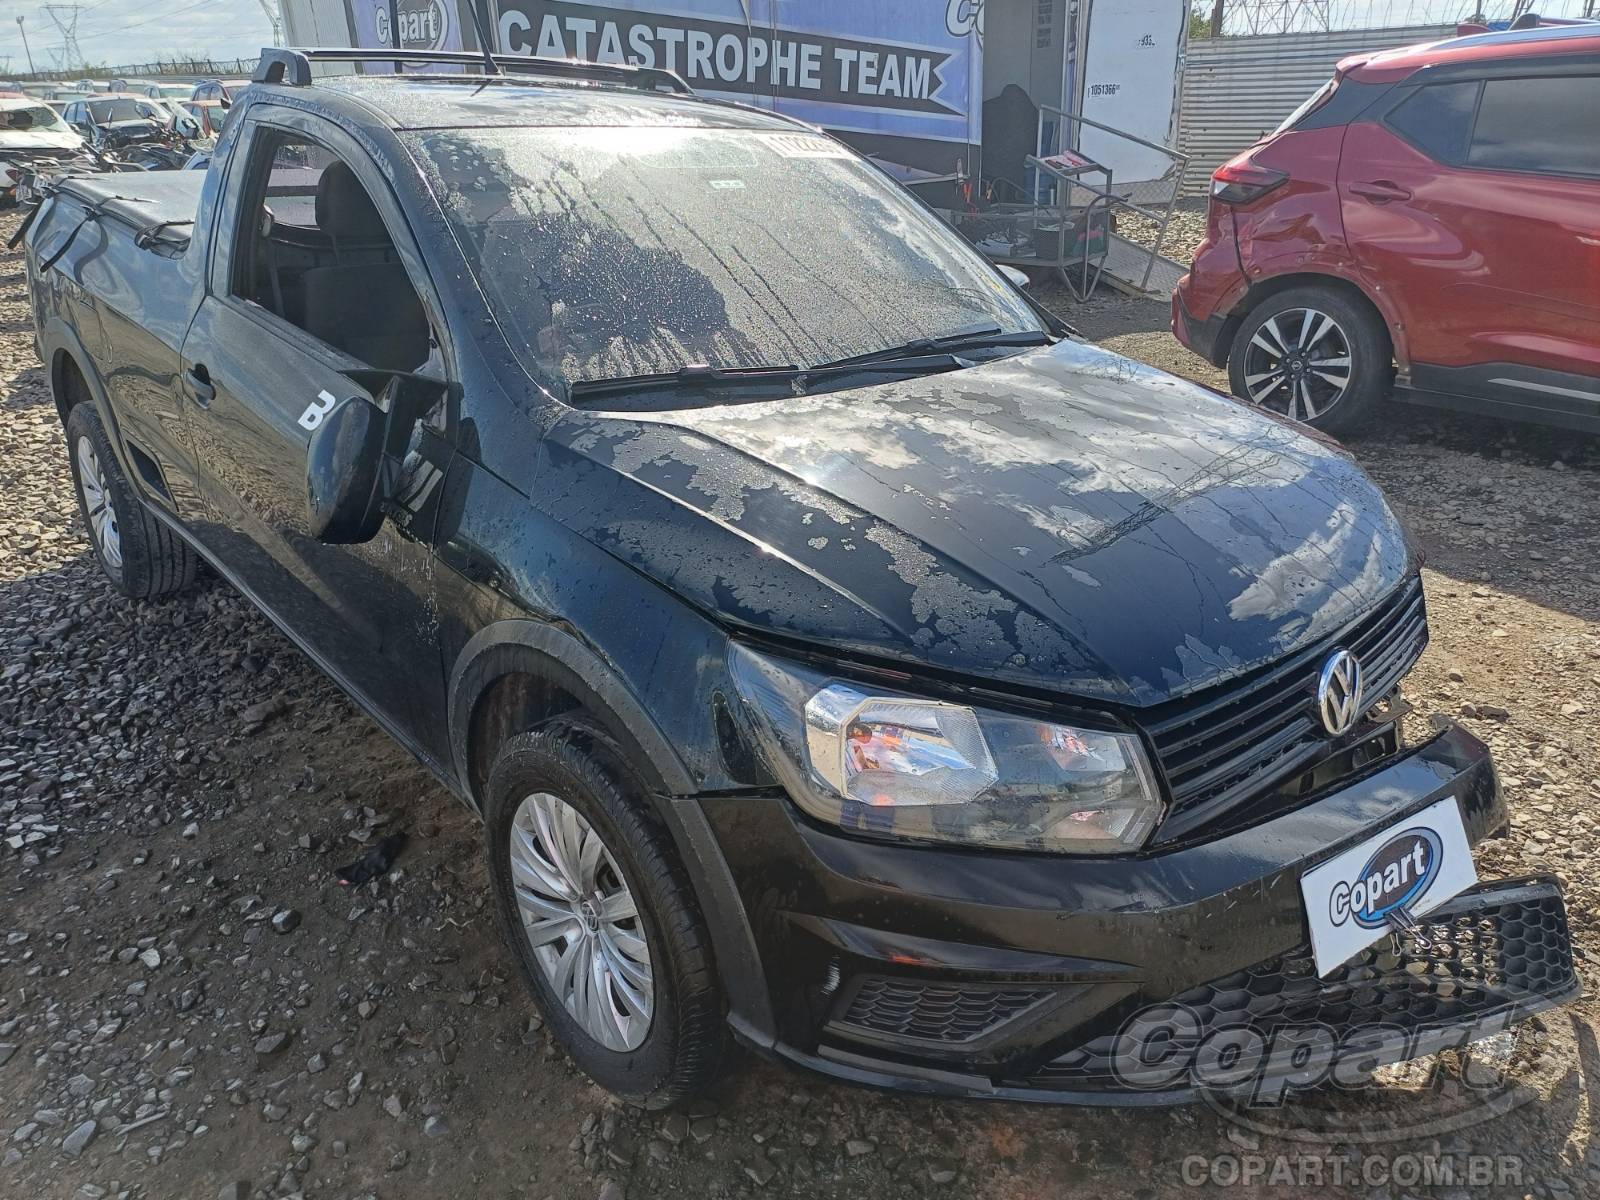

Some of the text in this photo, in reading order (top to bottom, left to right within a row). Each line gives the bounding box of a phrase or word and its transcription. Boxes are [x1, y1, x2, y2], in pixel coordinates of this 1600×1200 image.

[375, 3, 437, 49] Cpart
[499, 10, 931, 99] CATASTROPHE TEAM
[1329, 840, 1426, 928] Copart
